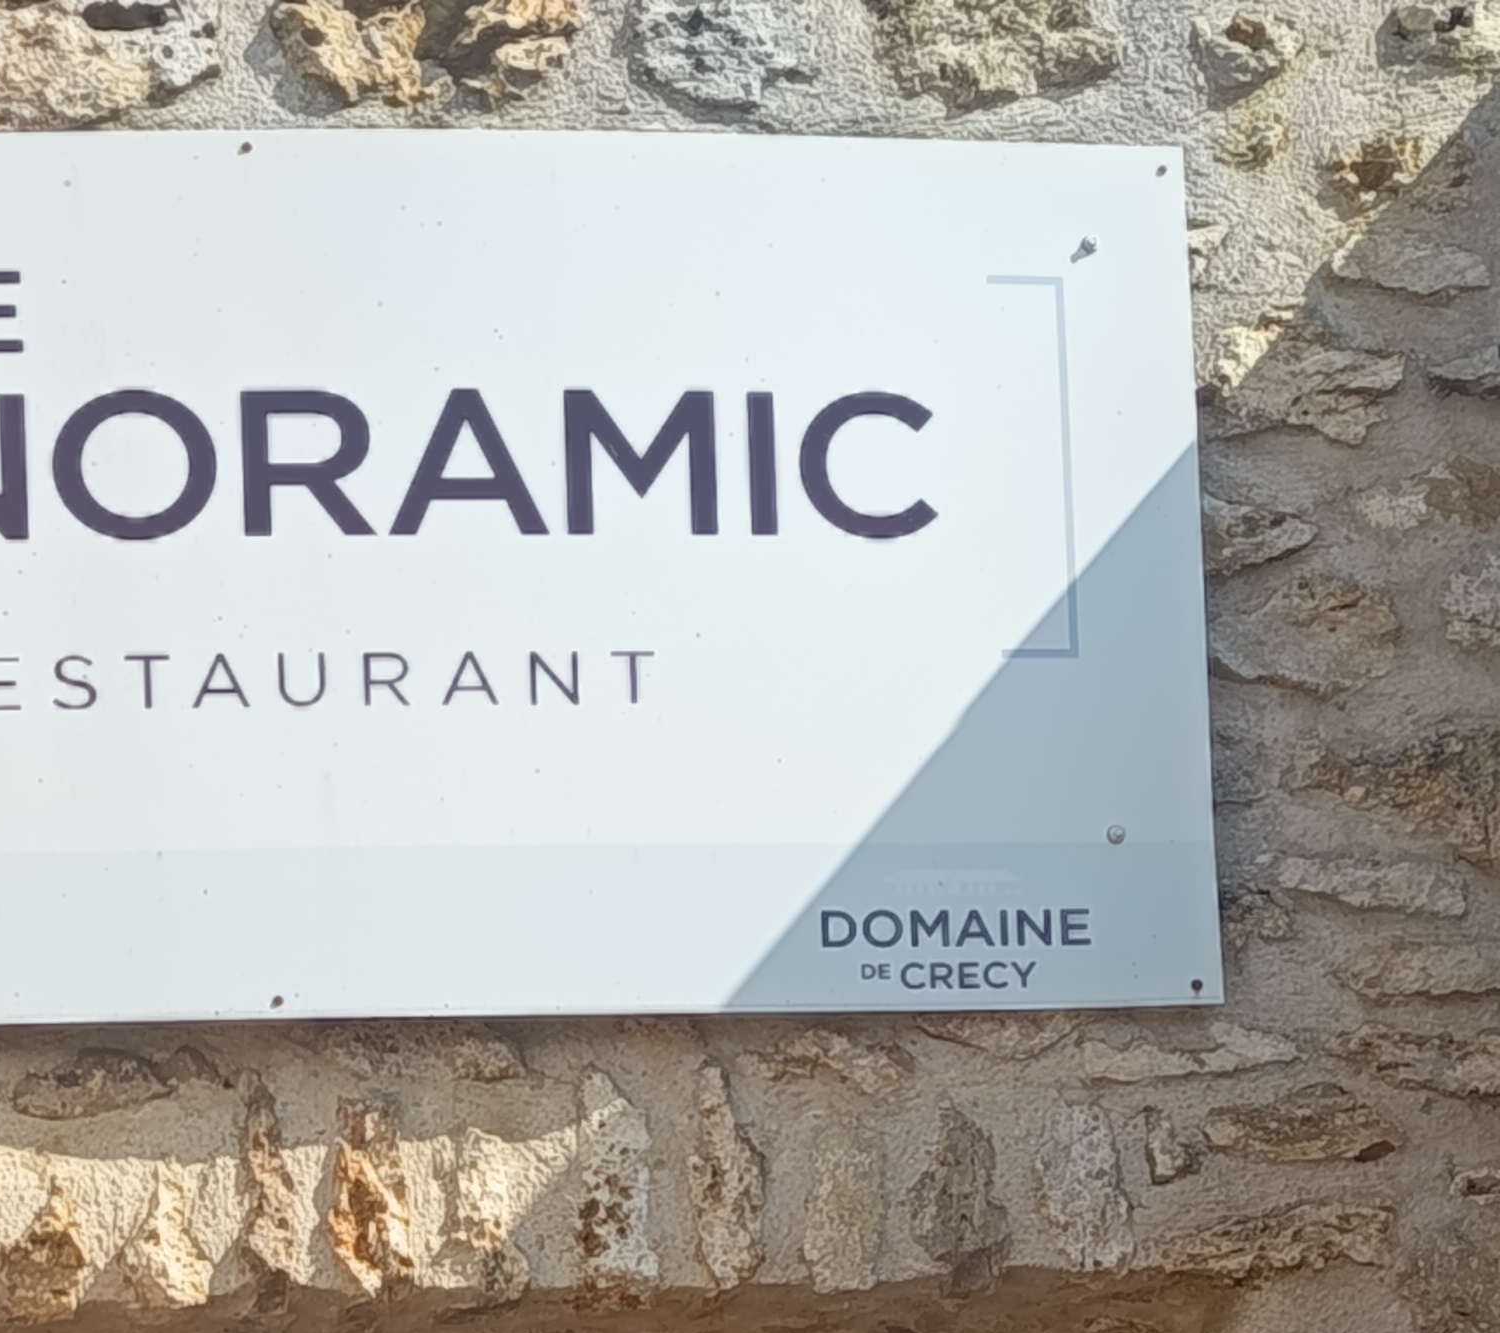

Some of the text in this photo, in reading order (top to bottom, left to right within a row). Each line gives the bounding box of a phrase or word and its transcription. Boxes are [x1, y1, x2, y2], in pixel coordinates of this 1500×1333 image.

[820, 908, 1092, 948] DOMAINE
[861, 961, 1037, 990] DE CRECY
